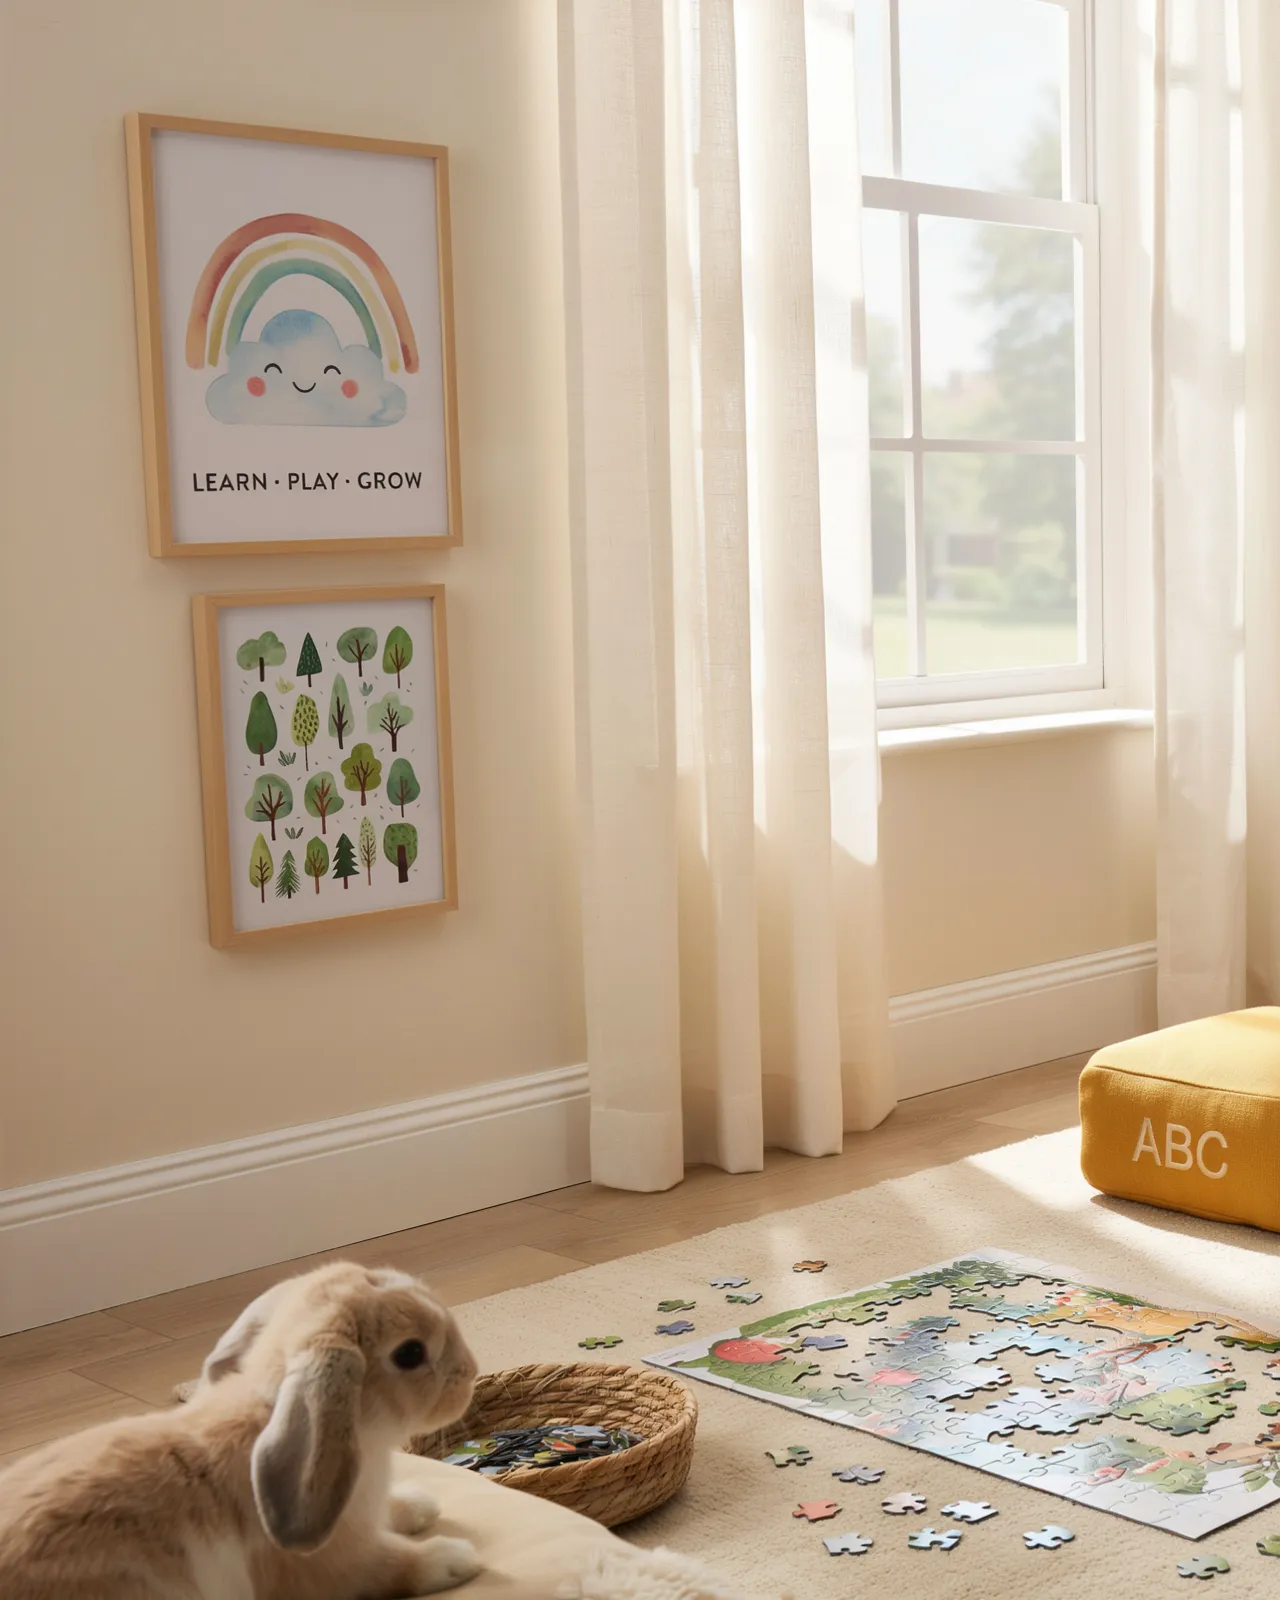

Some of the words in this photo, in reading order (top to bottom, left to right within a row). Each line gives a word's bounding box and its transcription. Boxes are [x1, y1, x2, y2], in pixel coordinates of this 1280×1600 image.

[192, 472, 267, 492] LEARN
[288, 472, 339, 490] PLAY
[357, 471, 422, 489] GROW
[1131, 1117, 1229, 1180] ABC
